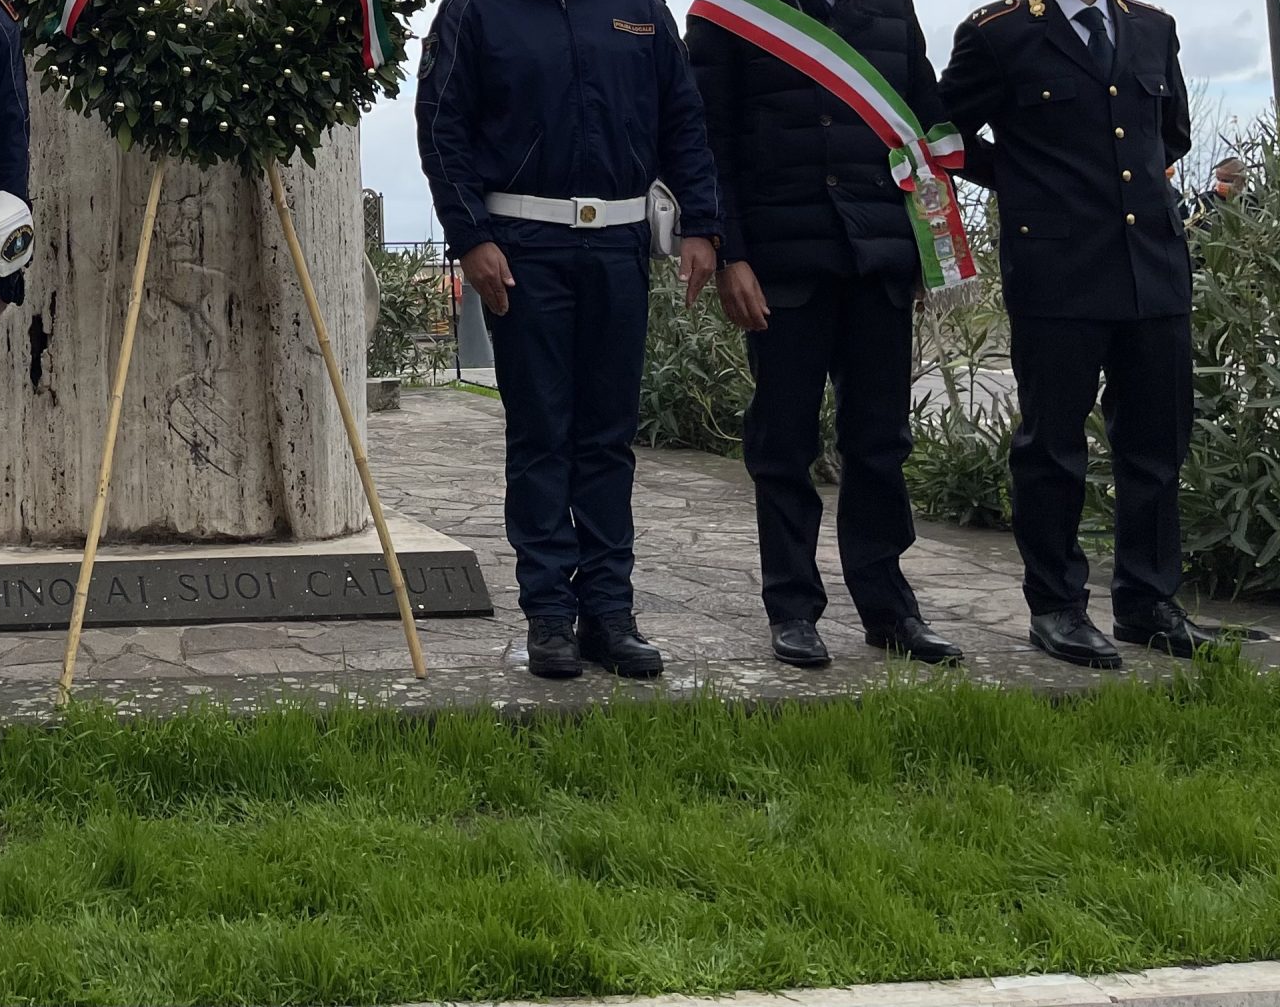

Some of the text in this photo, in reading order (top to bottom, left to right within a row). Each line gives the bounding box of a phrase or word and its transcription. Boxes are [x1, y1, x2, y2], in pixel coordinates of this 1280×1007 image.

[106, 575, 149, 604] AI
[177, 573, 277, 603] SUOI
[306, 565, 480, 598] CADUTI
